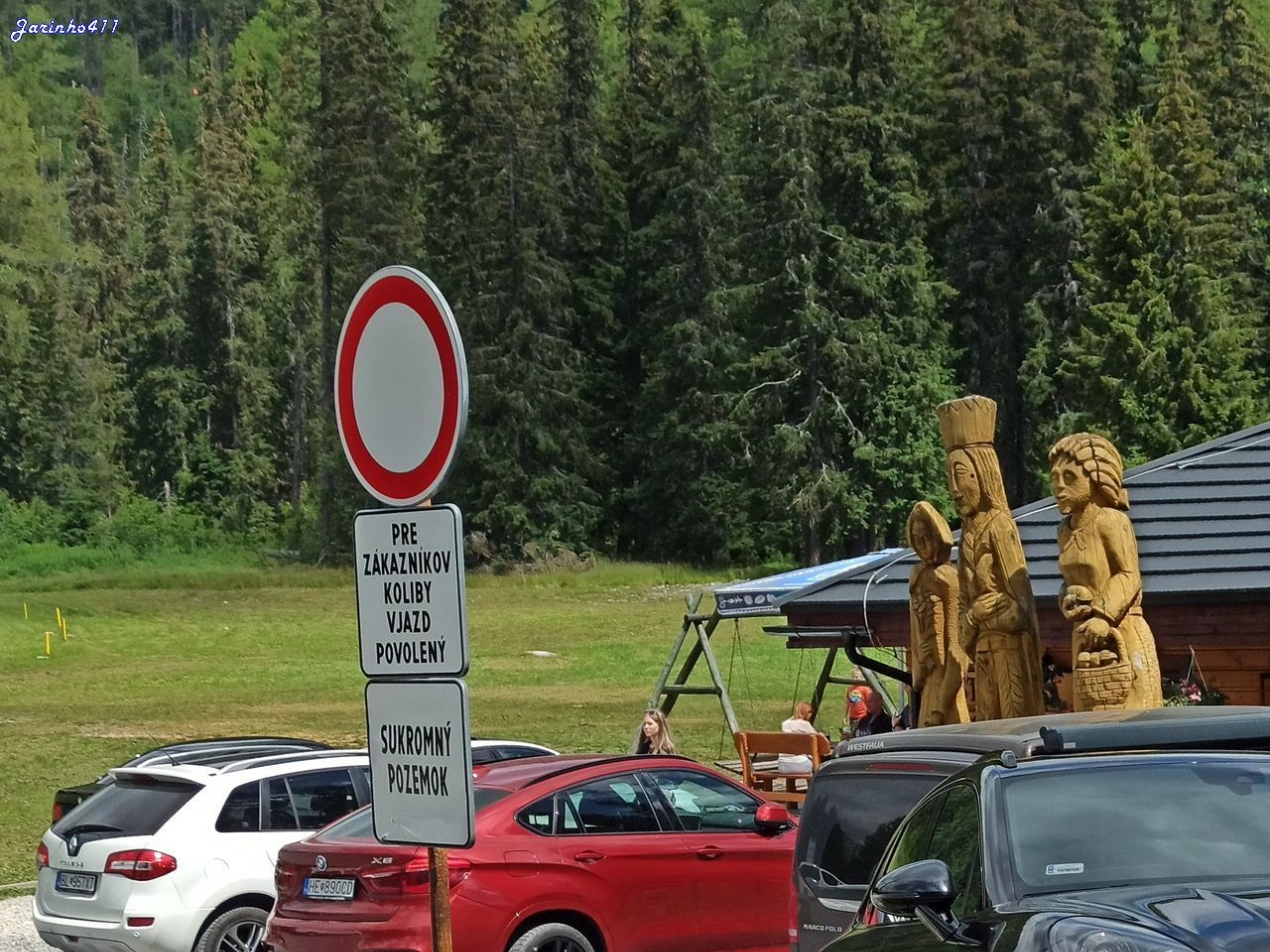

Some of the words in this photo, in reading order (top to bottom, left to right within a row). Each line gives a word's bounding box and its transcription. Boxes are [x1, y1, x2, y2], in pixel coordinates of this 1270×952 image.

[391, 522, 418, 546] PRE
[362, 546, 451, 576] ZÁKAZNÍKOV
[383, 580, 432, 604] KOLIBY
[386, 610, 431, 633] VJAZD
[376, 635, 446, 665] POVOLENÝ
[380, 721, 452, 757] SUKROMNÝ
[847, 740, 885, 752] WESTFALIA
[387, 763, 450, 797] POZEMOK
[370, 856, 394, 865] X6
